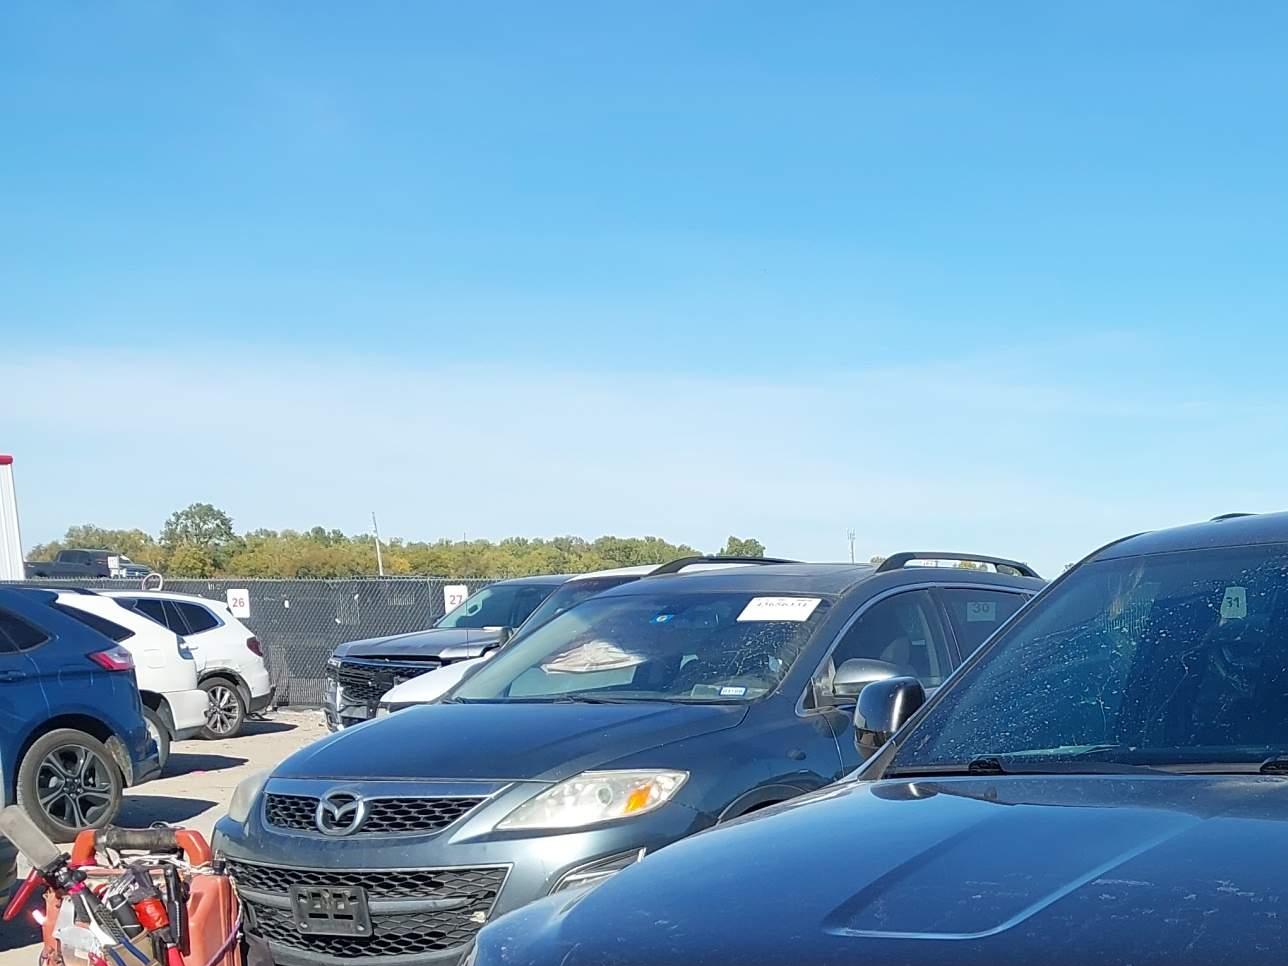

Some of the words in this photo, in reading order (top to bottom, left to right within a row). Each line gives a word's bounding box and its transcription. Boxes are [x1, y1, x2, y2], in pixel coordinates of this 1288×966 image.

[232, 597, 245, 608] 26
[449, 594, 463, 605] 27
[1226, 596, 1240, 608] 31
